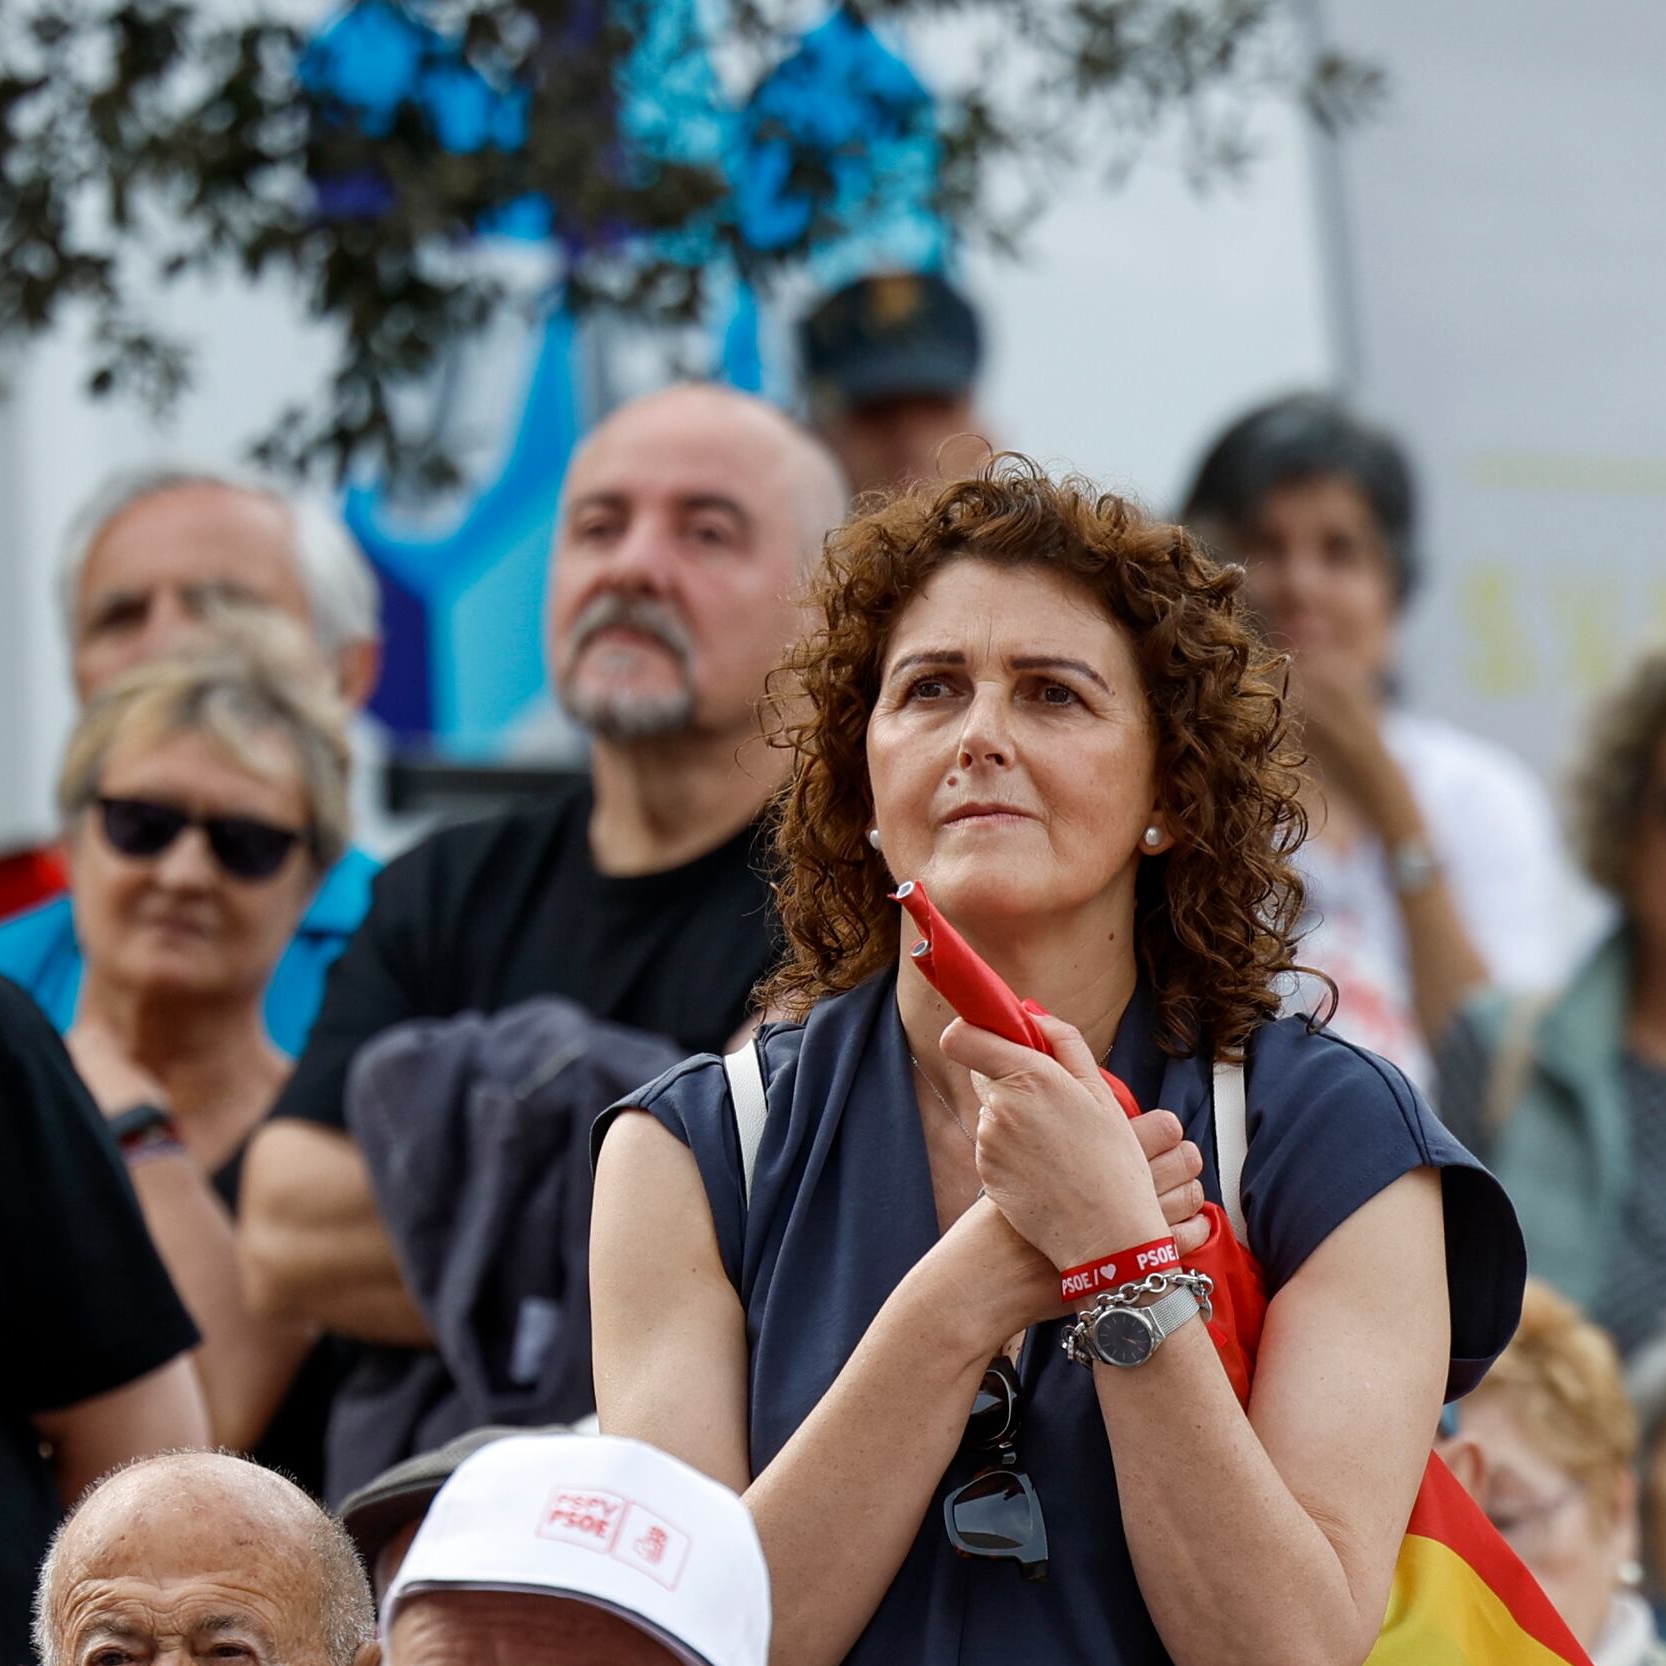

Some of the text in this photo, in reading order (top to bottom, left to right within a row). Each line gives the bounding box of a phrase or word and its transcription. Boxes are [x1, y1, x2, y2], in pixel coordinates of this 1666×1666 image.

[1062, 1273, 1093, 1296] PSOE
[1136, 1245, 1174, 1270] PSOE
[547, 1509, 610, 1539] PSOE
